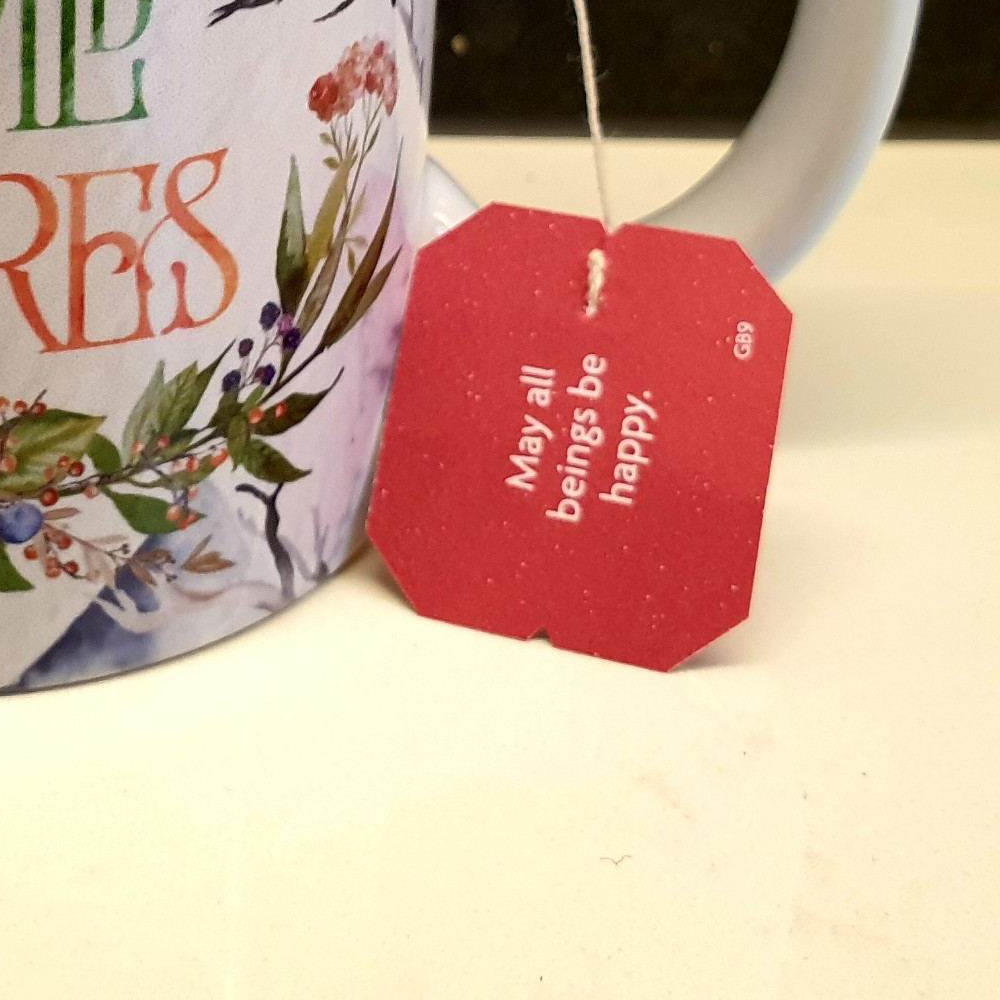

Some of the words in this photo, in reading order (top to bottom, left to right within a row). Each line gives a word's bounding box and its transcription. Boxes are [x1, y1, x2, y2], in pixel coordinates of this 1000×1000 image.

[732, 320, 754, 361] GB9
[518, 364, 557, 408] all
[566, 353, 608, 398] be
[504, 414, 555, 492] May
[545, 406, 605, 523] beings
[598, 389, 659, 506] happy.
